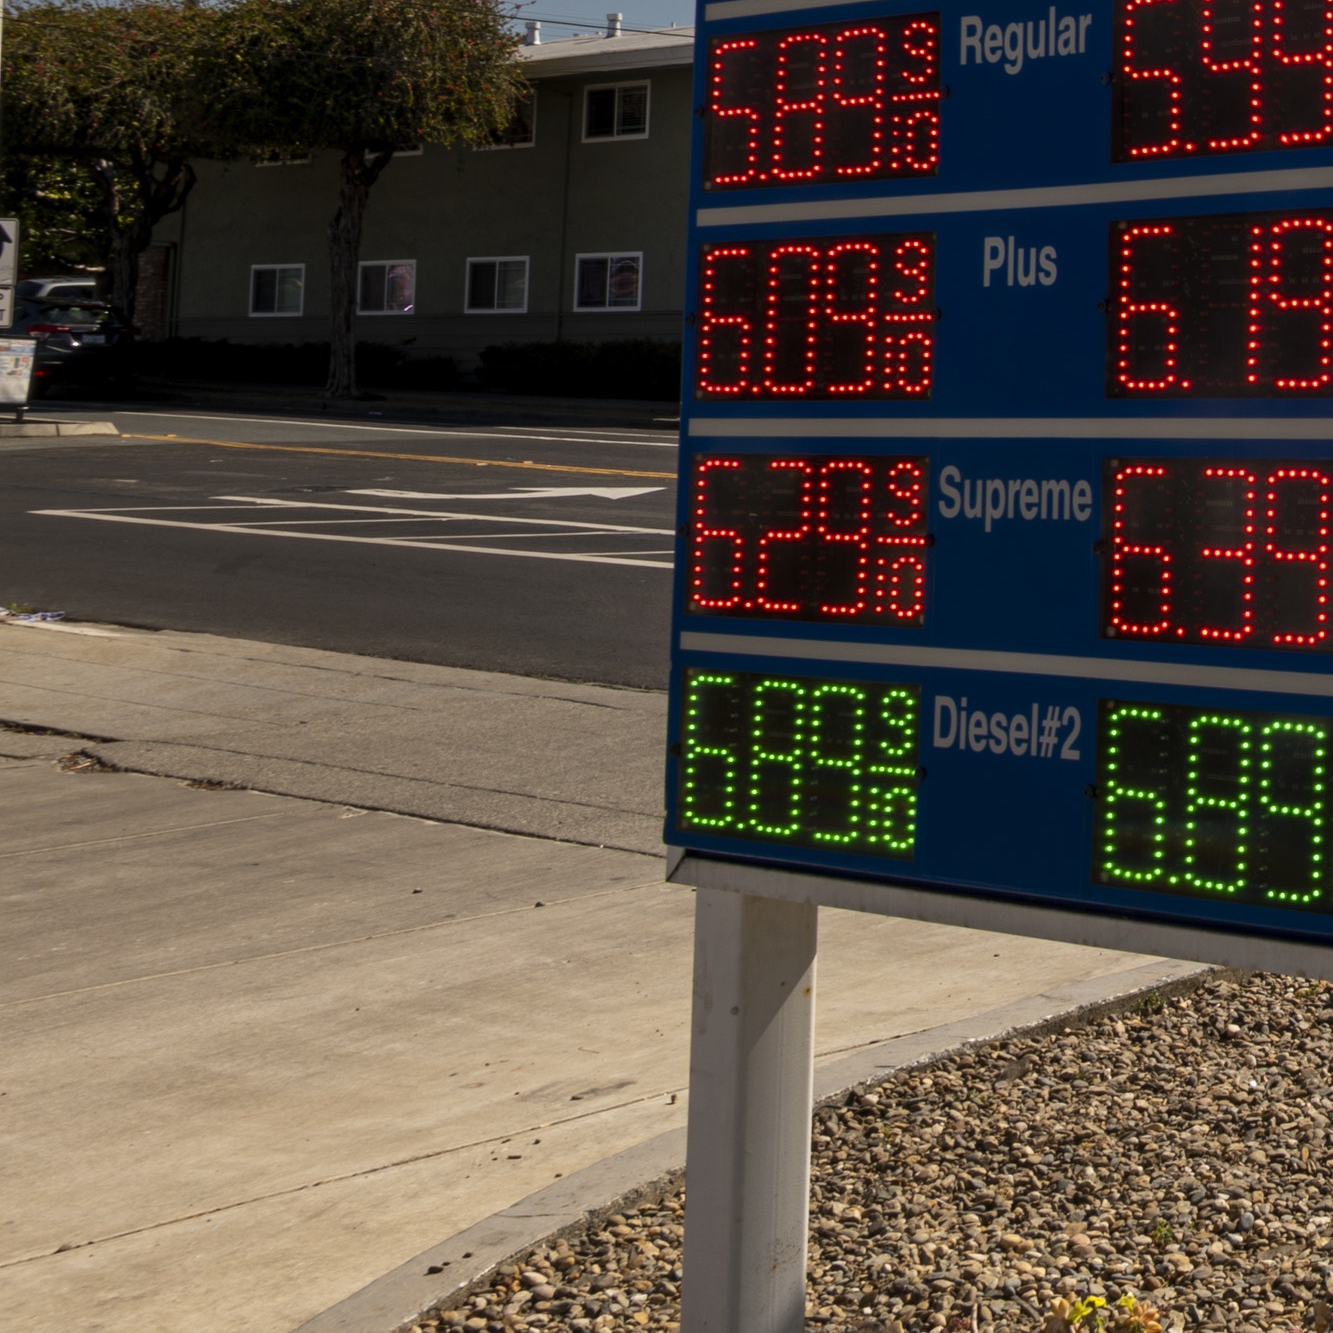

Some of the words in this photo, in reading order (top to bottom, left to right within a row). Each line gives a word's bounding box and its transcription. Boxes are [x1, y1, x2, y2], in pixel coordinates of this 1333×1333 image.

[959, 6, 1093, 75] Regular
[982, 235, 1058, 287] Plus
[938, 464, 1093, 533] Supreme
[933, 695, 1082, 761] Diesel#2
